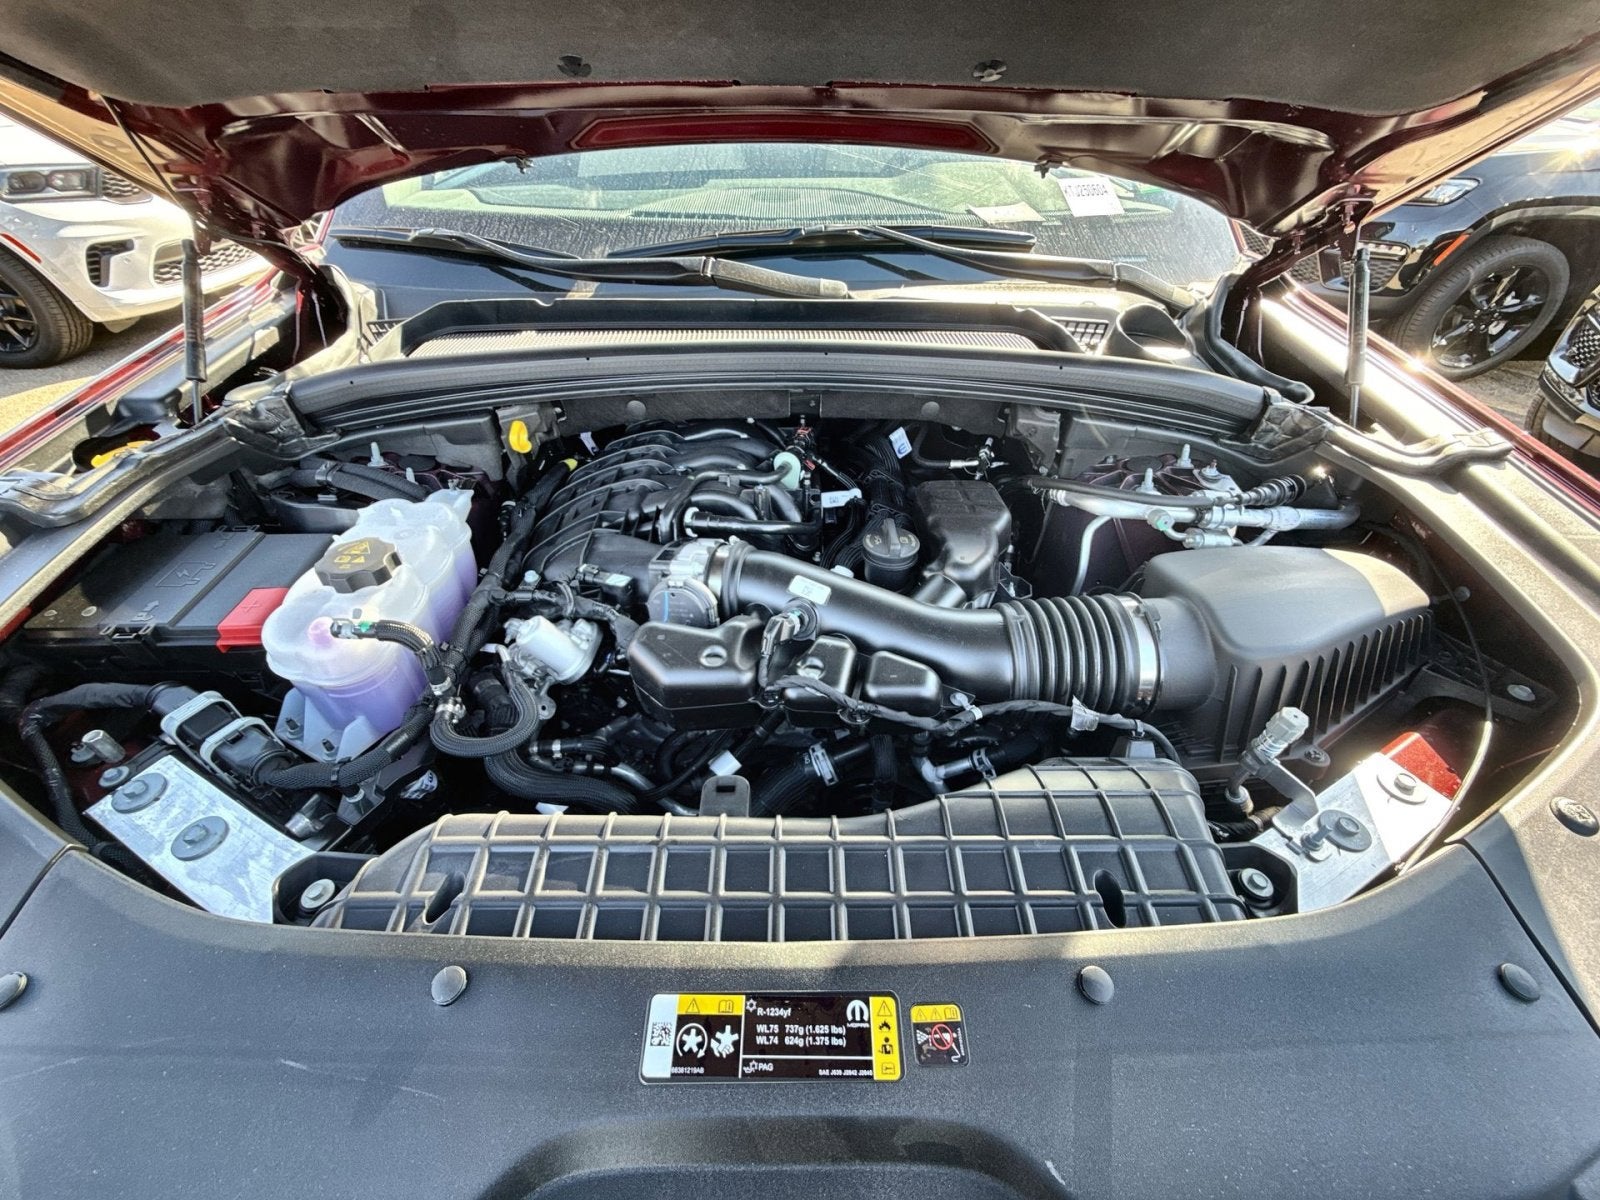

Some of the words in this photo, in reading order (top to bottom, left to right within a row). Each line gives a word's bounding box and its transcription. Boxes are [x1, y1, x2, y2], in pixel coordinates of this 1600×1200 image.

[757, 1007, 792, 1018] R-1234yf
[756, 1024, 779, 1033] WL75
[785, 1025, 804, 1035] 737g
[805, 1025, 829, 1035] (1.625
[831, 1025, 846, 1035] lbs)
[756, 1036, 779, 1045] WL74
[784, 1036, 804, 1047] 624g
[805, 1037, 829, 1047] (1.375
[831, 1037, 847, 1047] lbs)
[758, 1063, 774, 1072] PAG
